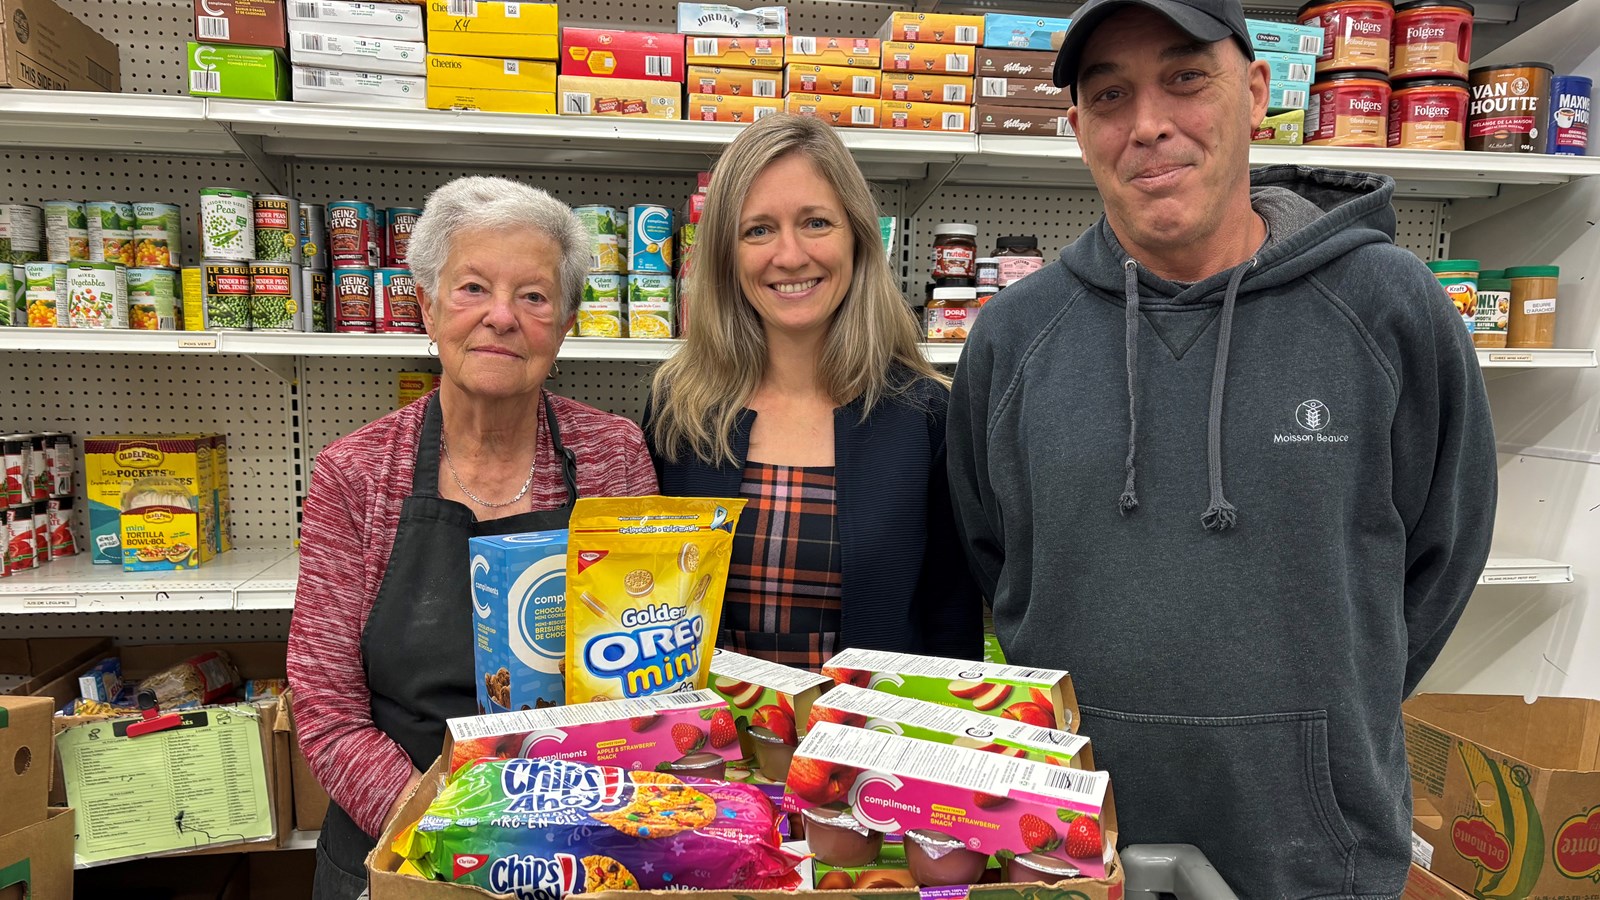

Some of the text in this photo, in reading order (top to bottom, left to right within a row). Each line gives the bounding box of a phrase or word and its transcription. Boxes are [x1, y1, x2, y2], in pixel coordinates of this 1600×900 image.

[698, 13, 741, 29] JORDANS
[1350, 20, 1382, 34] Folgers
[1407, 27, 1445, 40] Folgers
[432, 58, 462, 69] Cheerios
[1003, 62, 1034, 75] Kellogg's
[20, 62, 36, 84] THIS
[1473, 82, 1508, 100] VAN
[1350, 98, 1382, 112] Folgers
[1470, 96, 1538, 116] HOUTTE
[1414, 106, 1450, 118] Folgers
[1003, 118, 1034, 130] Kellogg's
[216, 204, 236, 214] Peas
[258, 201, 287, 209] SIEUR
[332, 210, 356, 218] HEINZ
[397, 216, 418, 224] HEIN
[332, 219, 358, 229] FEVES
[946, 250, 970, 258] nutella
[71, 279, 106, 287] Vegetables
[343, 277, 367, 286] HEINZ
[340, 286, 369, 295] FEVES
[1476, 295, 1499, 308] NLY
[1274, 433, 1349, 443] Moisson Beauce
[117, 469, 166, 478] POCKETS
[476, 582, 498, 596] compliments
[622, 604, 687, 627] Golden
[587, 616, 703, 672] OREO
[626, 645, 698, 694] mini
[619, 742, 657, 752] STRAWBERRY
[504, 795, 600, 813] Ahoy
[864, 795, 921, 814] compliments
[930, 818, 953, 828] SNACK
[931, 812, 951, 820] APPLE
[957, 816, 1000, 830] STRAWBERRY
[1455, 828, 1505, 862] Del Monte
[517, 885, 561, 900] hoy
